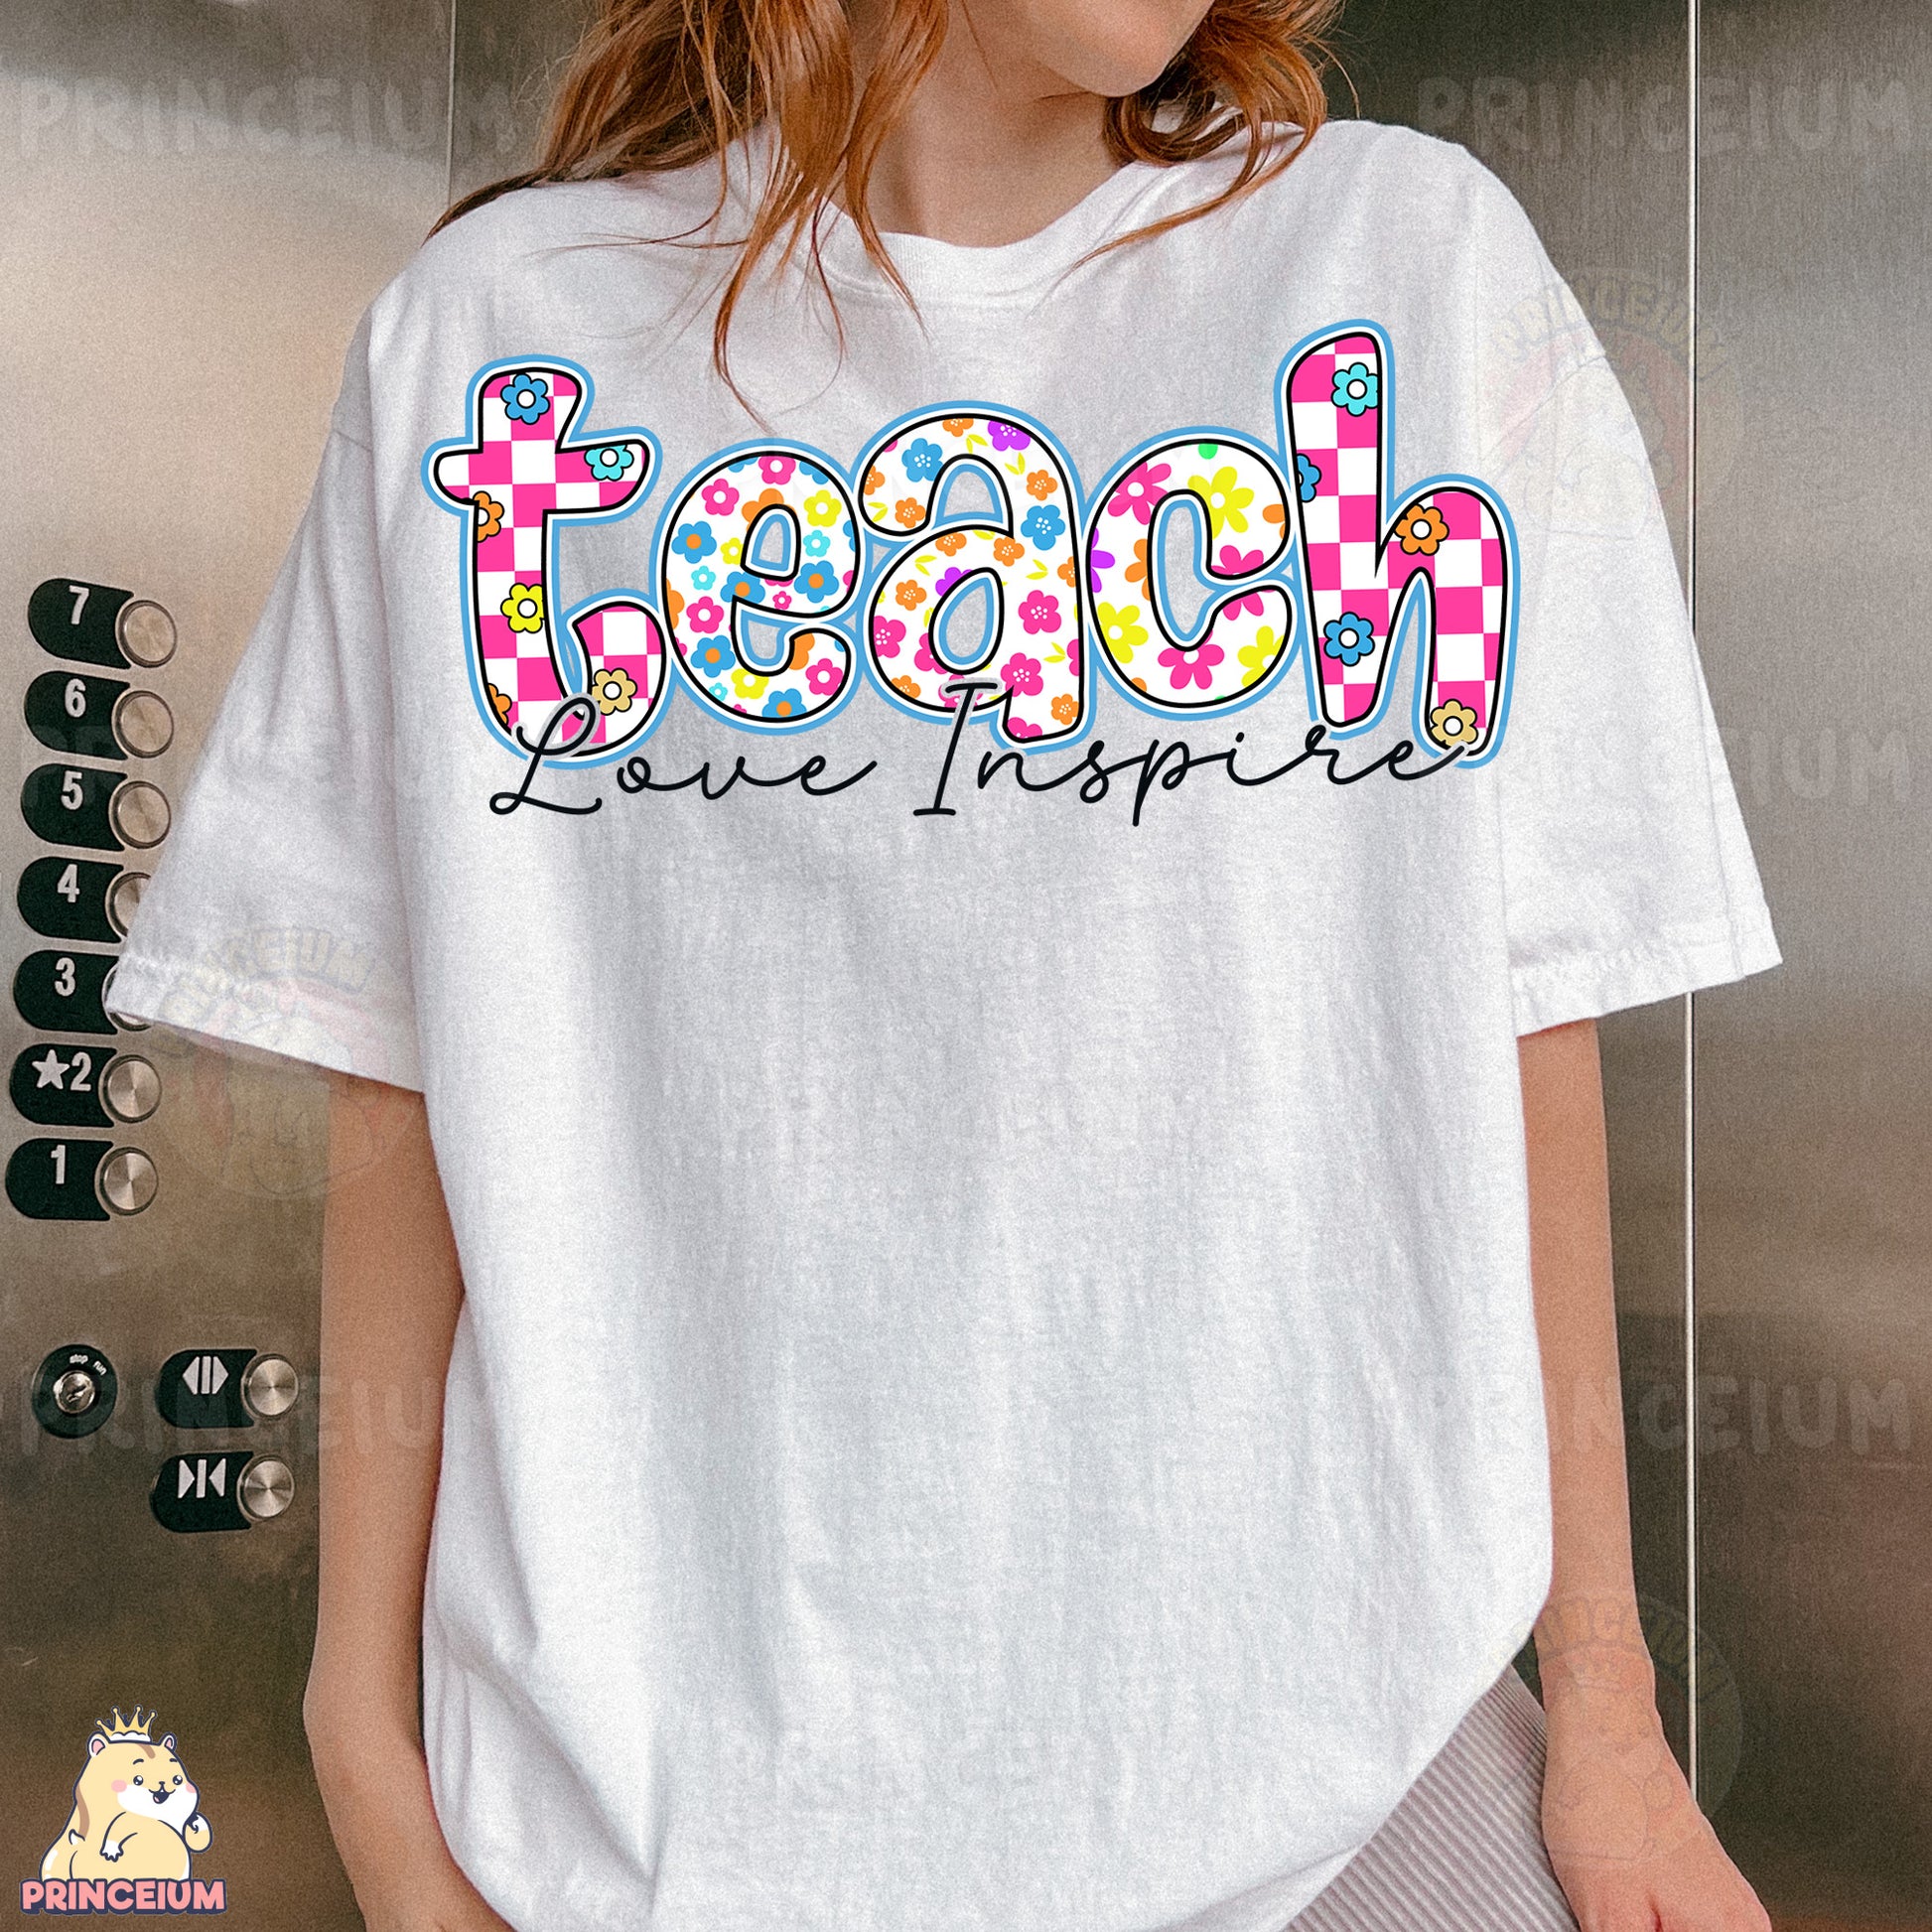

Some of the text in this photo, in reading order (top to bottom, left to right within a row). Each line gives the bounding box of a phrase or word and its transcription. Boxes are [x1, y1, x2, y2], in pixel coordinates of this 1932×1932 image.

[427, 322, 1519, 764] teach
[67, 586, 90, 625] 7
[64, 678, 87, 718] 6
[488, 694, 878, 815] Love
[912, 682, 1465, 827] Inspire
[61, 770, 84, 811] 5
[57, 863, 80, 903] 4
[55, 956, 77, 997] 3
[50, 1144, 68, 1184] 1
